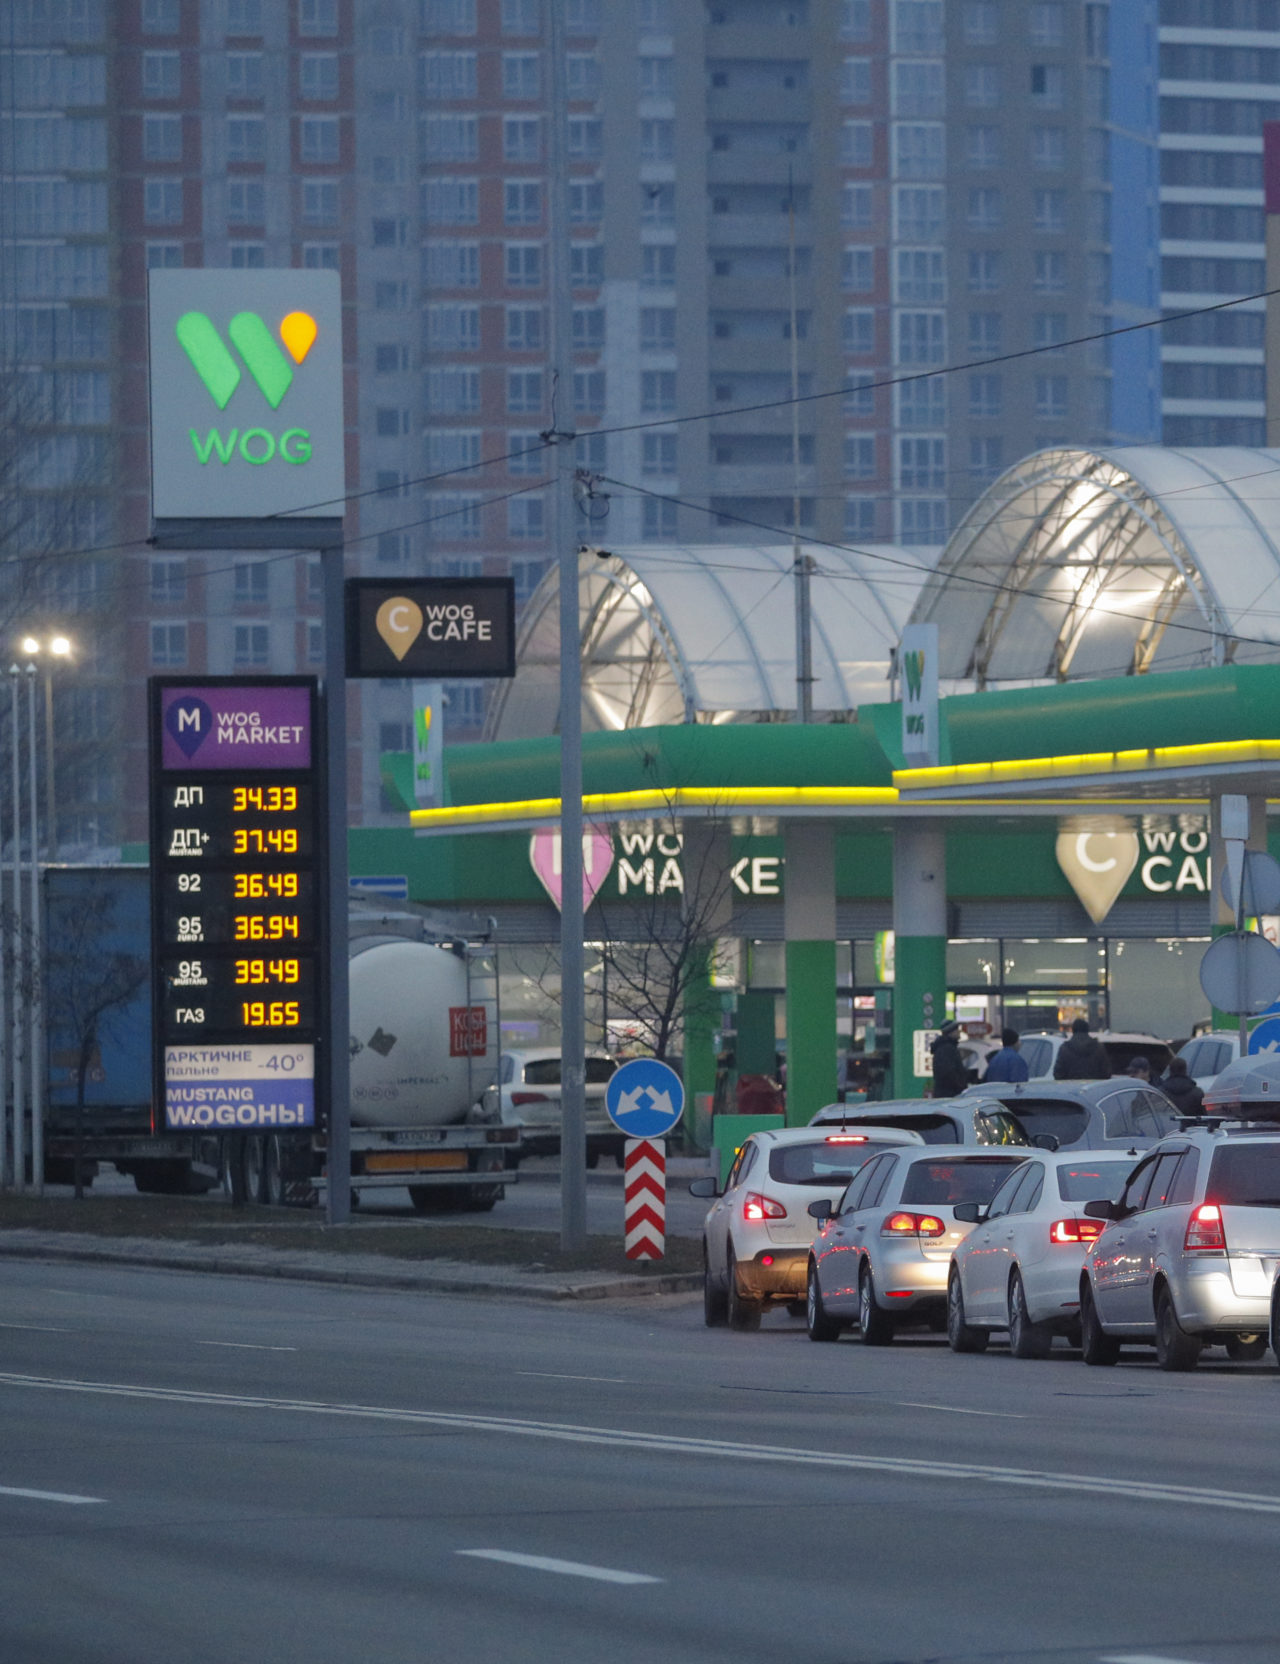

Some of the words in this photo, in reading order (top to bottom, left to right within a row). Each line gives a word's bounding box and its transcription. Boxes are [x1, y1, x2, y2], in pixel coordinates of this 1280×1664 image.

[189, 428, 312, 465] WOG
[389, 607, 409, 632] C
[426, 605, 474, 620] WOG
[427, 622, 492, 641] CAFE
[178, 708, 200, 732] M
[217, 712, 261, 726] WOG
[217, 726, 304, 744] MARKET
[174, 787, 203, 808] ДП
[233, 787, 298, 811] 34.33
[171, 829, 210, 849] ДП+
[233, 829, 298, 853] 37.49
[617, 826, 684, 856] WO
[1142, 825, 1208, 853] WO
[177, 874, 201, 892] 92
[234, 873, 299, 898] 36.49
[1142, 856, 1211, 892] CA
[178, 916, 202, 934] 95
[234, 915, 299, 940] 36.94
[179, 961, 203, 978] 95
[235, 959, 299, 984] 39.49
[176, 1008, 205, 1023] ГАЗ
[243, 1002, 299, 1026] 19.65
[166, 1051, 253, 1063] АРКТИЧНЕ
[166, 1065, 219, 1076] пальне
[166, 1087, 254, 1102] MUSTANG
